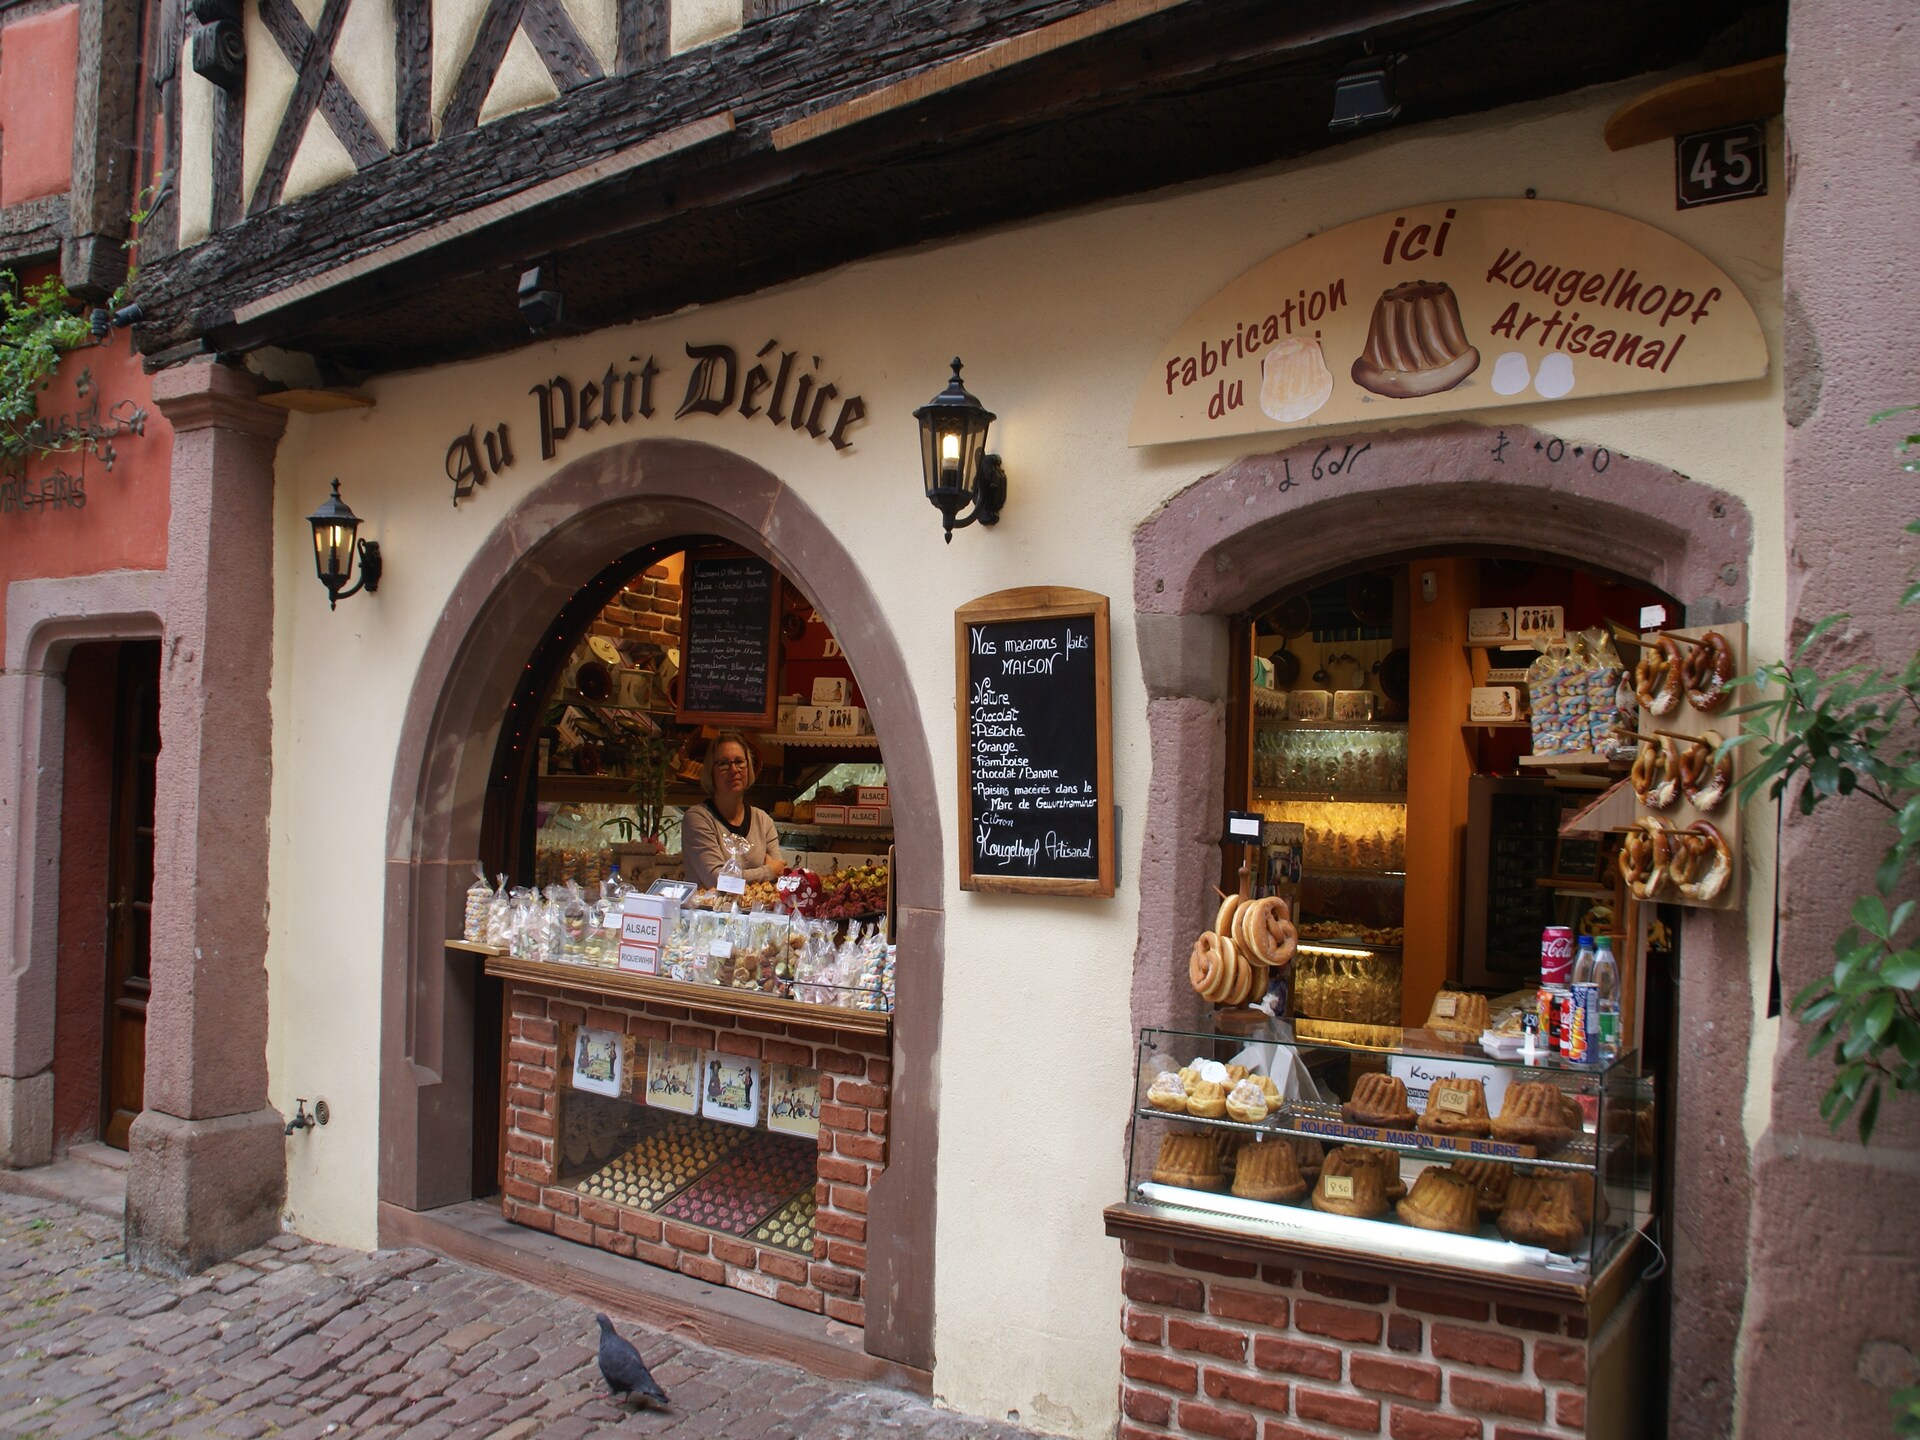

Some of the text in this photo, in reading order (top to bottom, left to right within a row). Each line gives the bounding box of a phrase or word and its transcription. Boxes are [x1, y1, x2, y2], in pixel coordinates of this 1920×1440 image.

[1690, 135, 1751, 190] 45
[1383, 209, 1456, 264] ici
[1486, 247, 1722, 326] Kougelhopf
[1165, 277, 1348, 395] Fabrication
[1491, 302, 1686, 374] Artisanal
[1207, 377, 1244, 420] du
[445, 339, 866, 507] Au Petit Délice
[971, 626, 1089, 661] Nos macarons faits
[861, 791, 886, 801] ALSACE
[991, 798, 1013, 811] Marc
[1018, 798, 1030, 809] de
[1055, 783, 1078, 794] dans
[1083, 780, 1092, 793] le
[851, 811, 877, 822] ALSACE
[625, 923, 657, 936] ALSACE
[620, 953, 654, 966] RIQUEWIHR
[1300, 1119, 1521, 1158] KOUGELHOPF MAISON AU BEURRE
